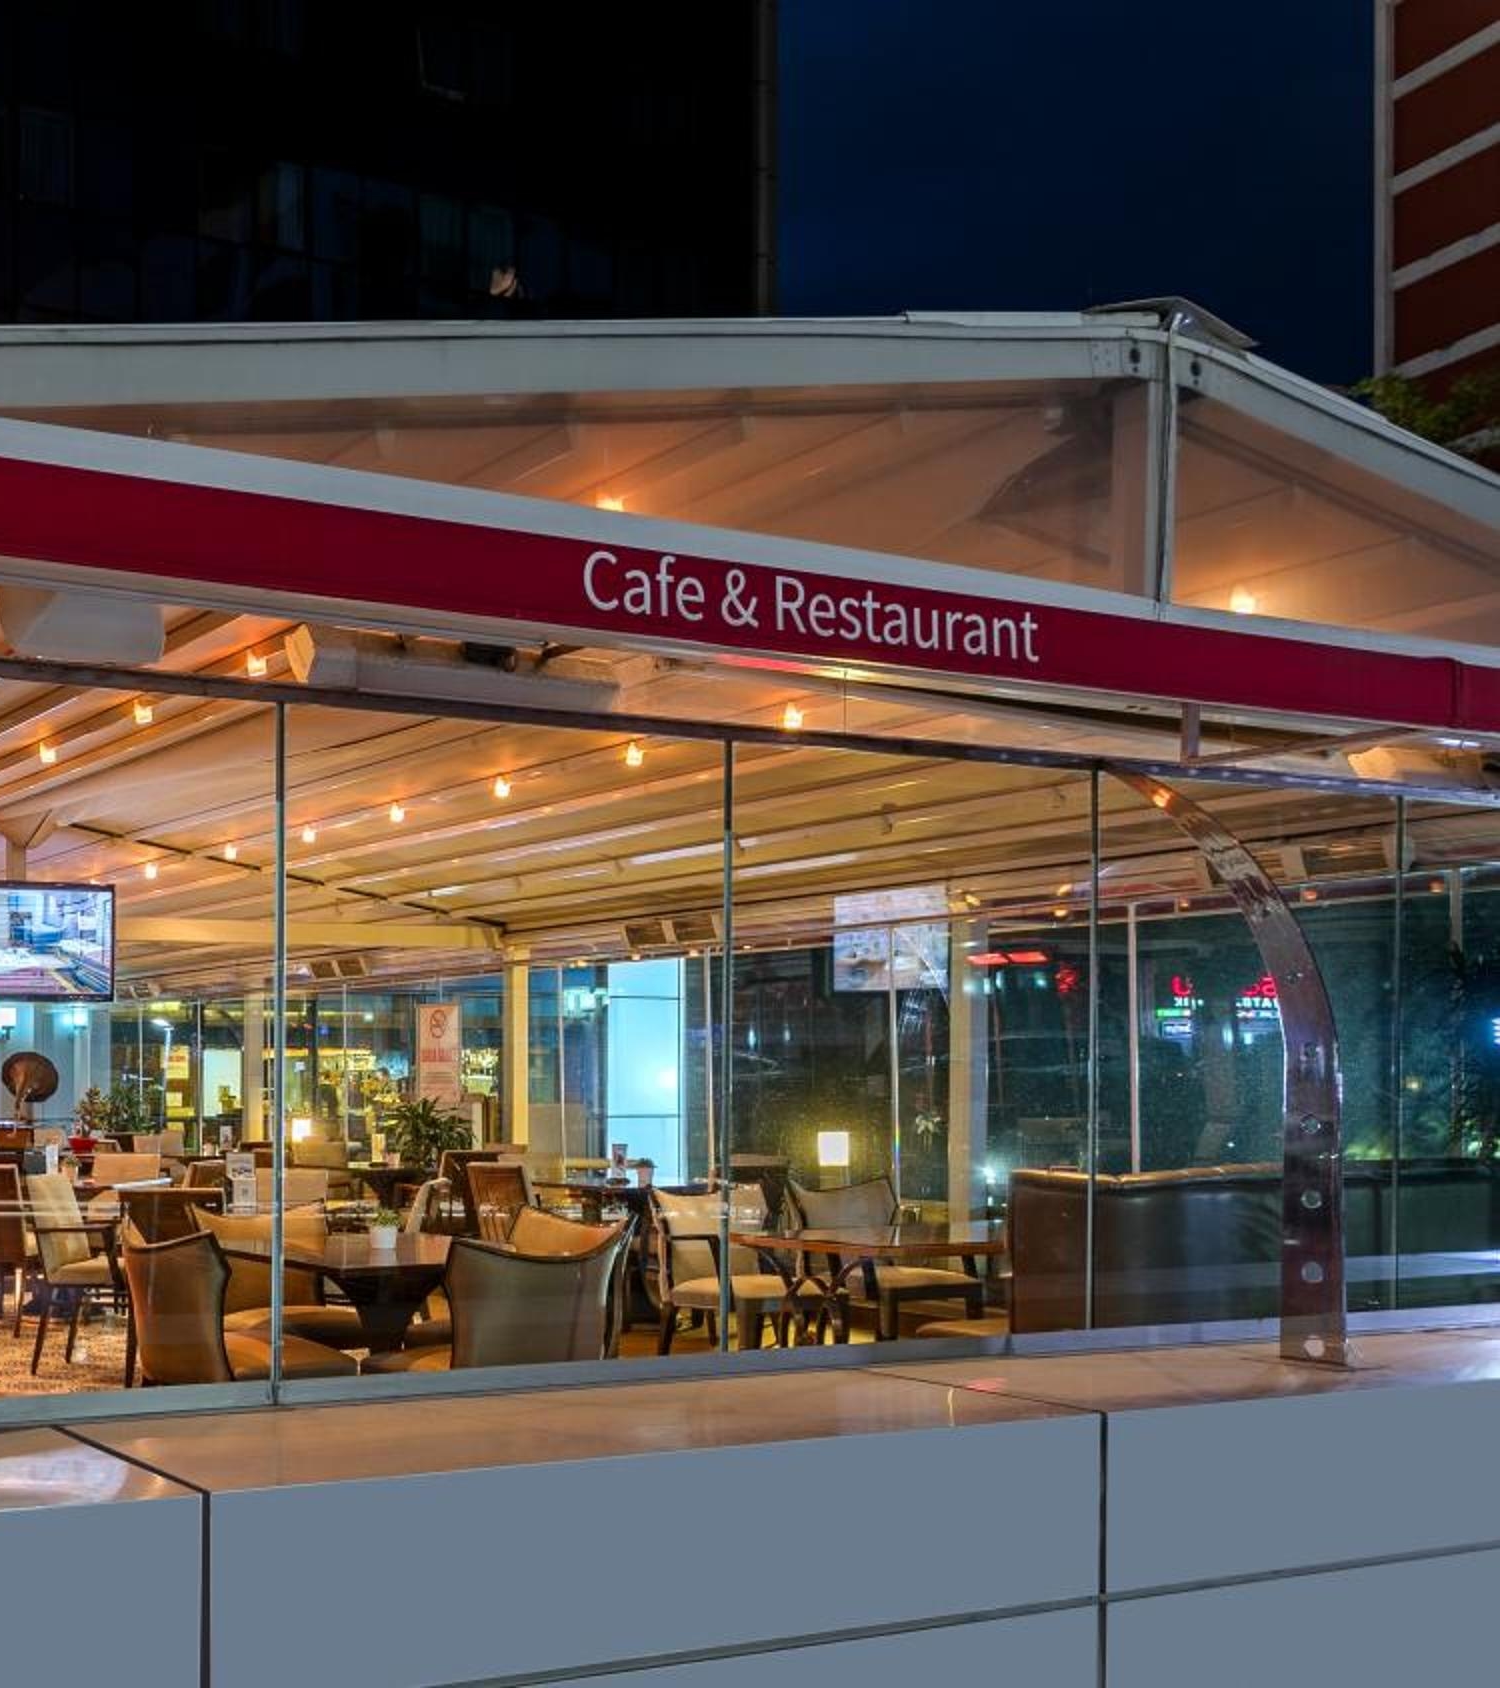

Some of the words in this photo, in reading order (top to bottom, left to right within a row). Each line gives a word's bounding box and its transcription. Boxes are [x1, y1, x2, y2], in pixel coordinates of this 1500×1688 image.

[583, 551, 705, 621] Cafe
[720, 569, 760, 628] &
[775, 575, 1040, 662] Restaurant
